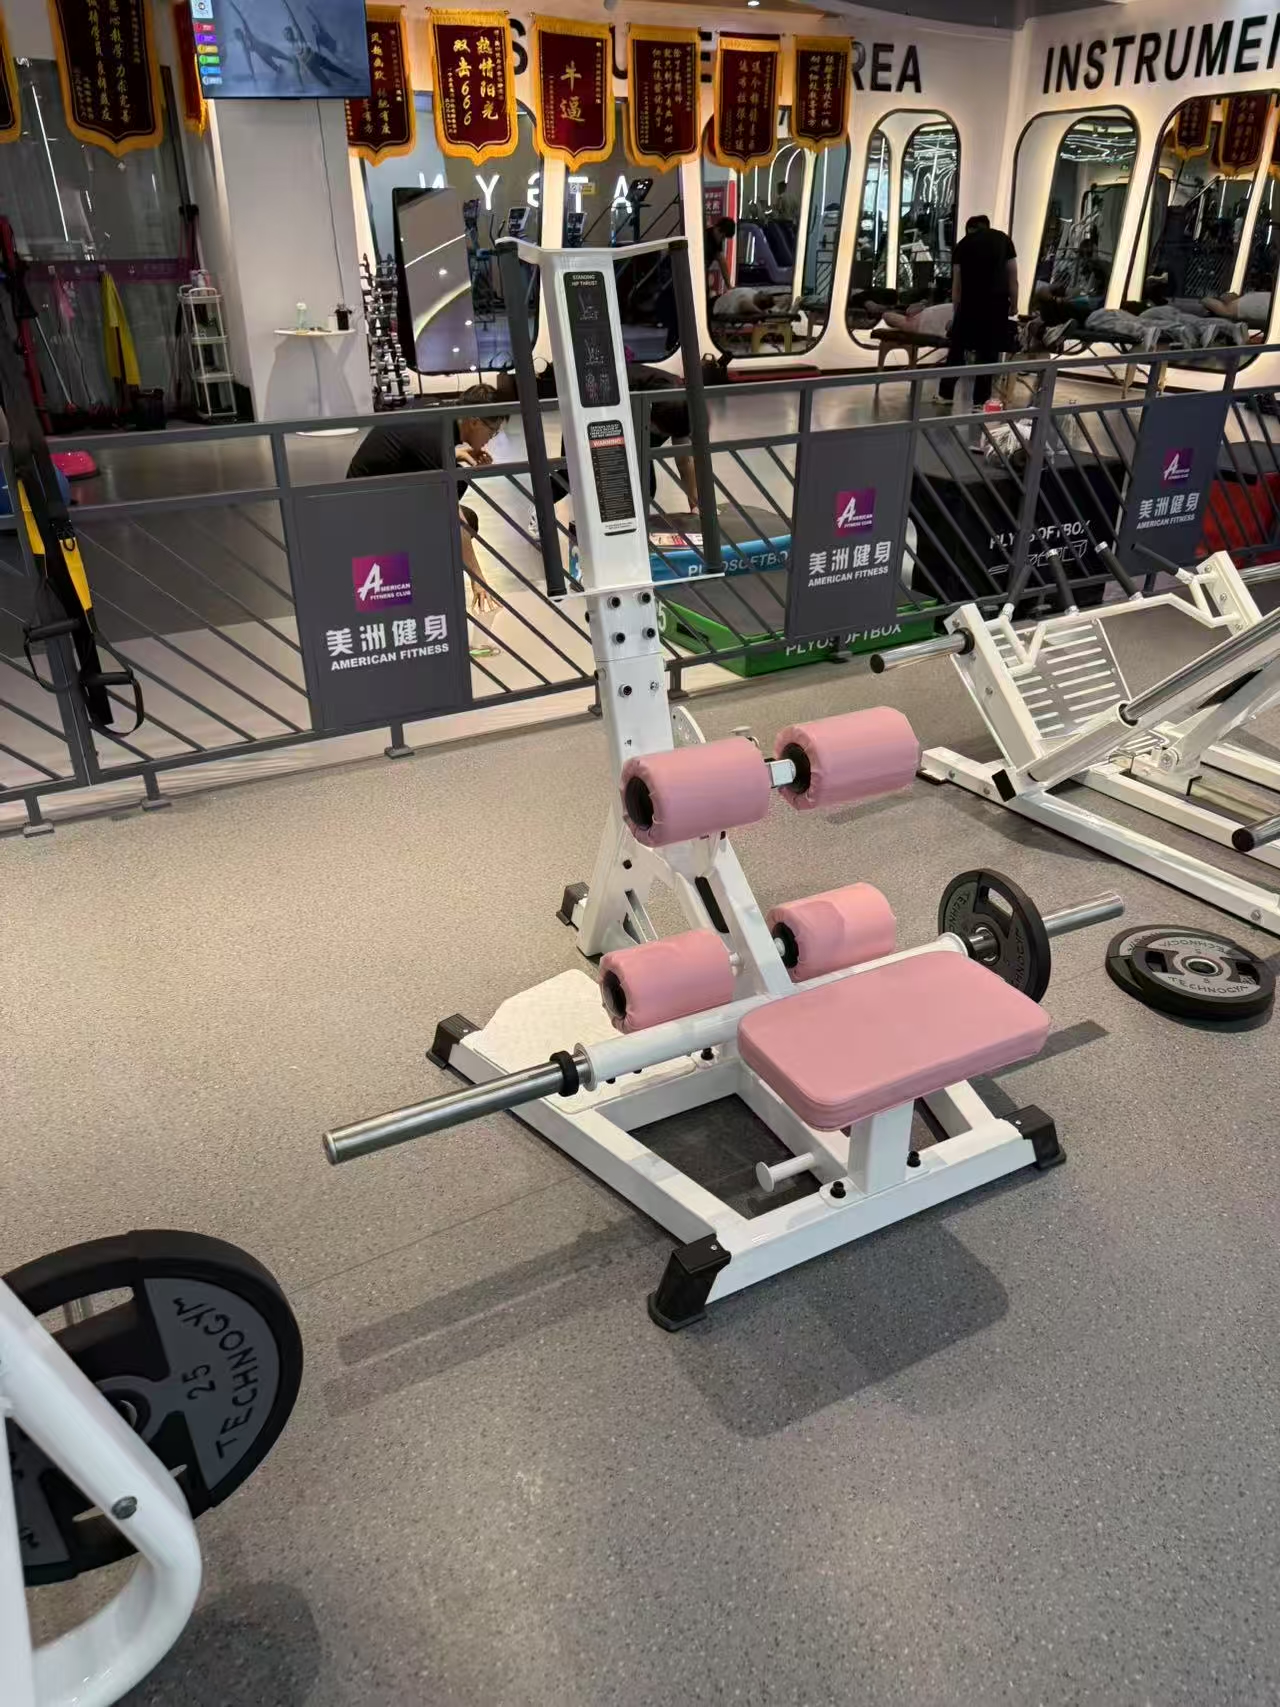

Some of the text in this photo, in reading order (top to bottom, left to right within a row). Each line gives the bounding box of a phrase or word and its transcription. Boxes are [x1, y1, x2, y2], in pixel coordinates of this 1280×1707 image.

[453, 38, 473, 126] 双击666
[476, 36, 499, 119] 热情阳光
[560, 60, 585, 121] 牛逼
[1136, 513, 1195, 530] AMERICAN FITNESS
[1138, 492, 1200, 519] 美洲健身
[809, 540, 892, 576] 美洲健身
[808, 565, 889, 588] AMERICAN FITNESS
[369, 590, 412, 601] FITNESS CLUB
[326, 614, 448, 657] 美洲健身
[330, 642, 449, 671] AMERICAN FITNESS
[182, 1364, 216, 1400] 25
